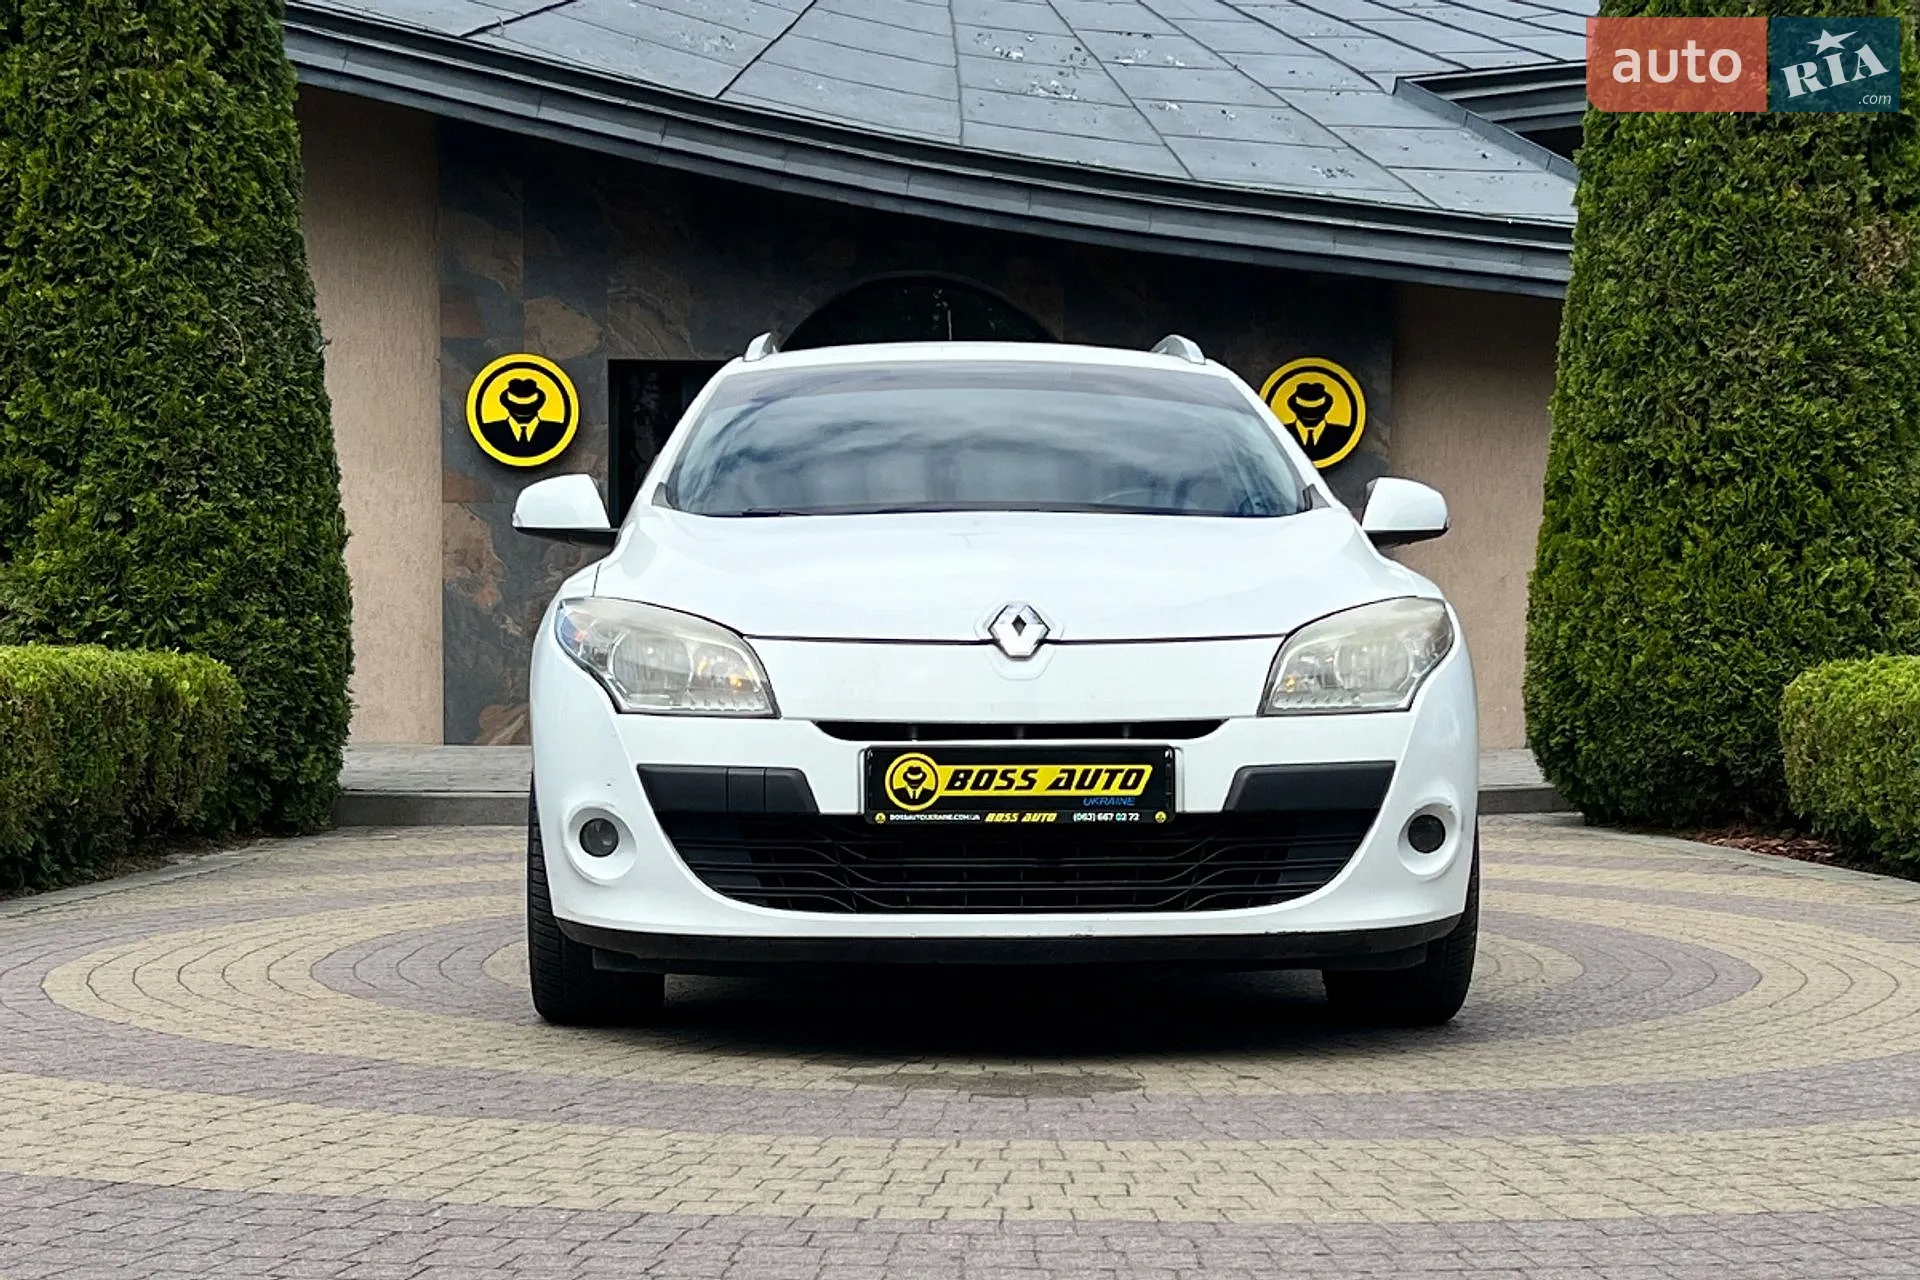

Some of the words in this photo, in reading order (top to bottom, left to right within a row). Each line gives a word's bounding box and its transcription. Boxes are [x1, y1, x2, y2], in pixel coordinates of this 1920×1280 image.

[945, 769, 1038, 790] BOSS
[1046, 769, 1146, 790] AUTO
[1083, 797, 1136, 806] UKRAINE
[985, 813, 1019, 822] BOSS
[1021, 813, 1057, 822] AUTO
